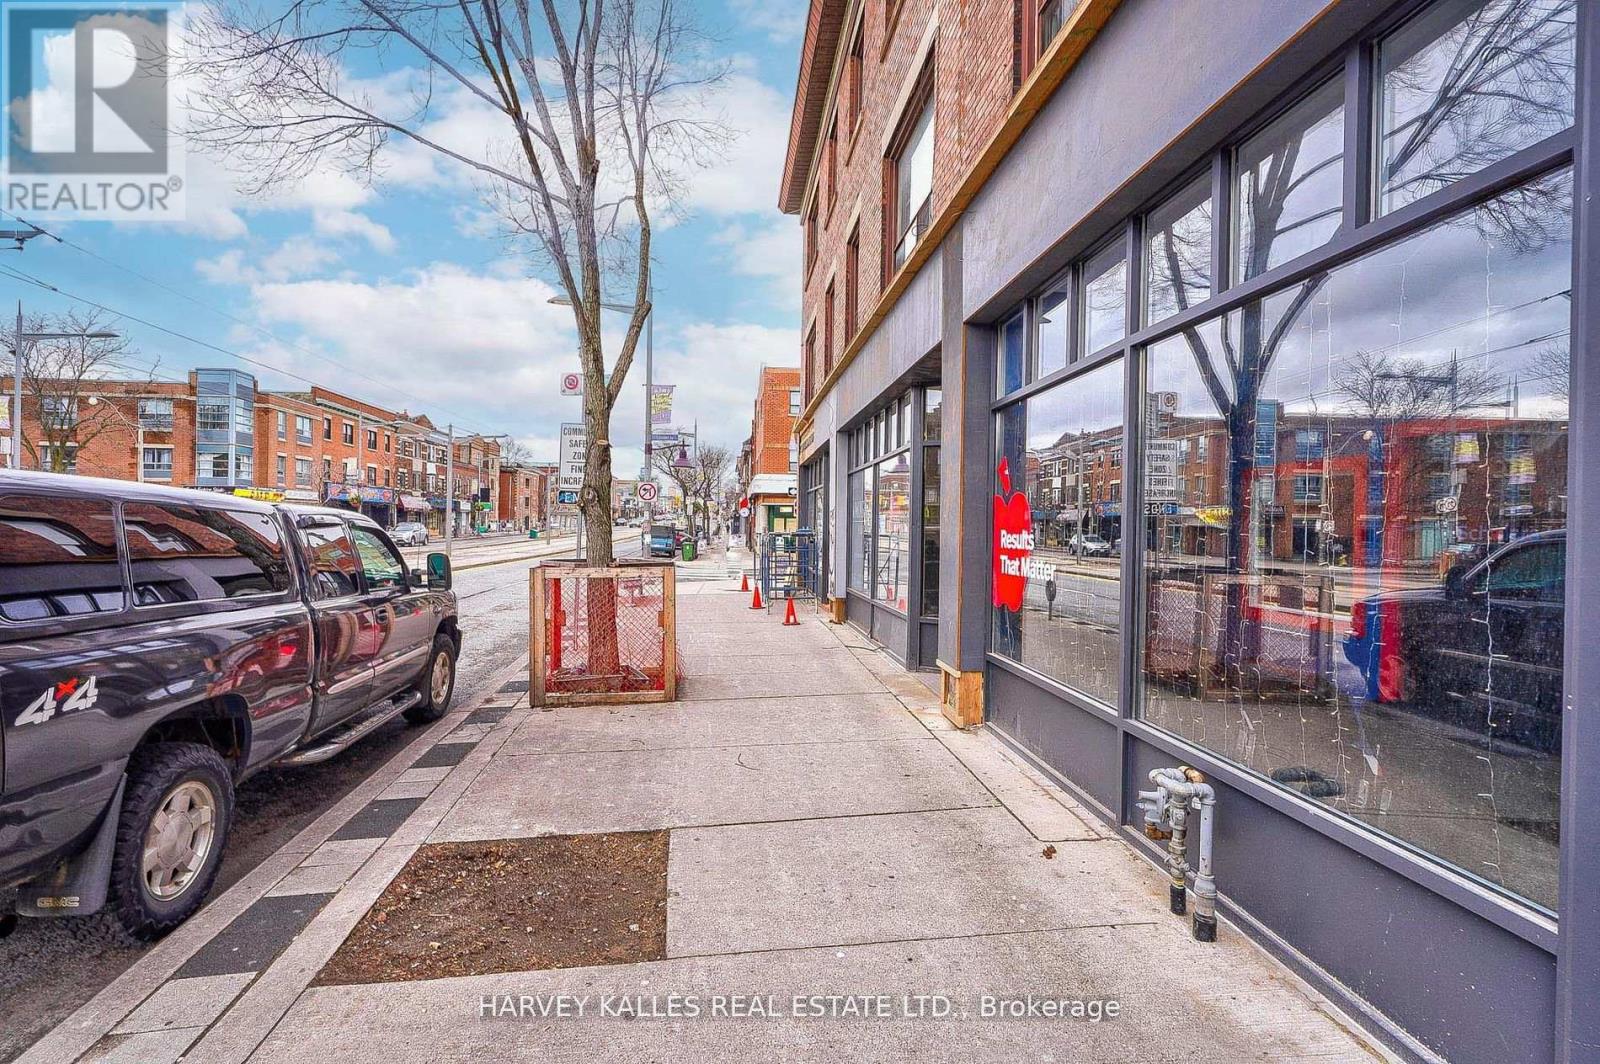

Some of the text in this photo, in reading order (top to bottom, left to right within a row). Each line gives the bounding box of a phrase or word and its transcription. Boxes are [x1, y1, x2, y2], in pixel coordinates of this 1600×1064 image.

[568, 439, 587, 448] SAFE
[572, 451, 586, 460] ZON
[570, 464, 587, 473] FINE
[1000, 528, 1035, 551] Results
[1000, 554, 1057, 582] That Matter
[36, 895, 80, 908] GMC
